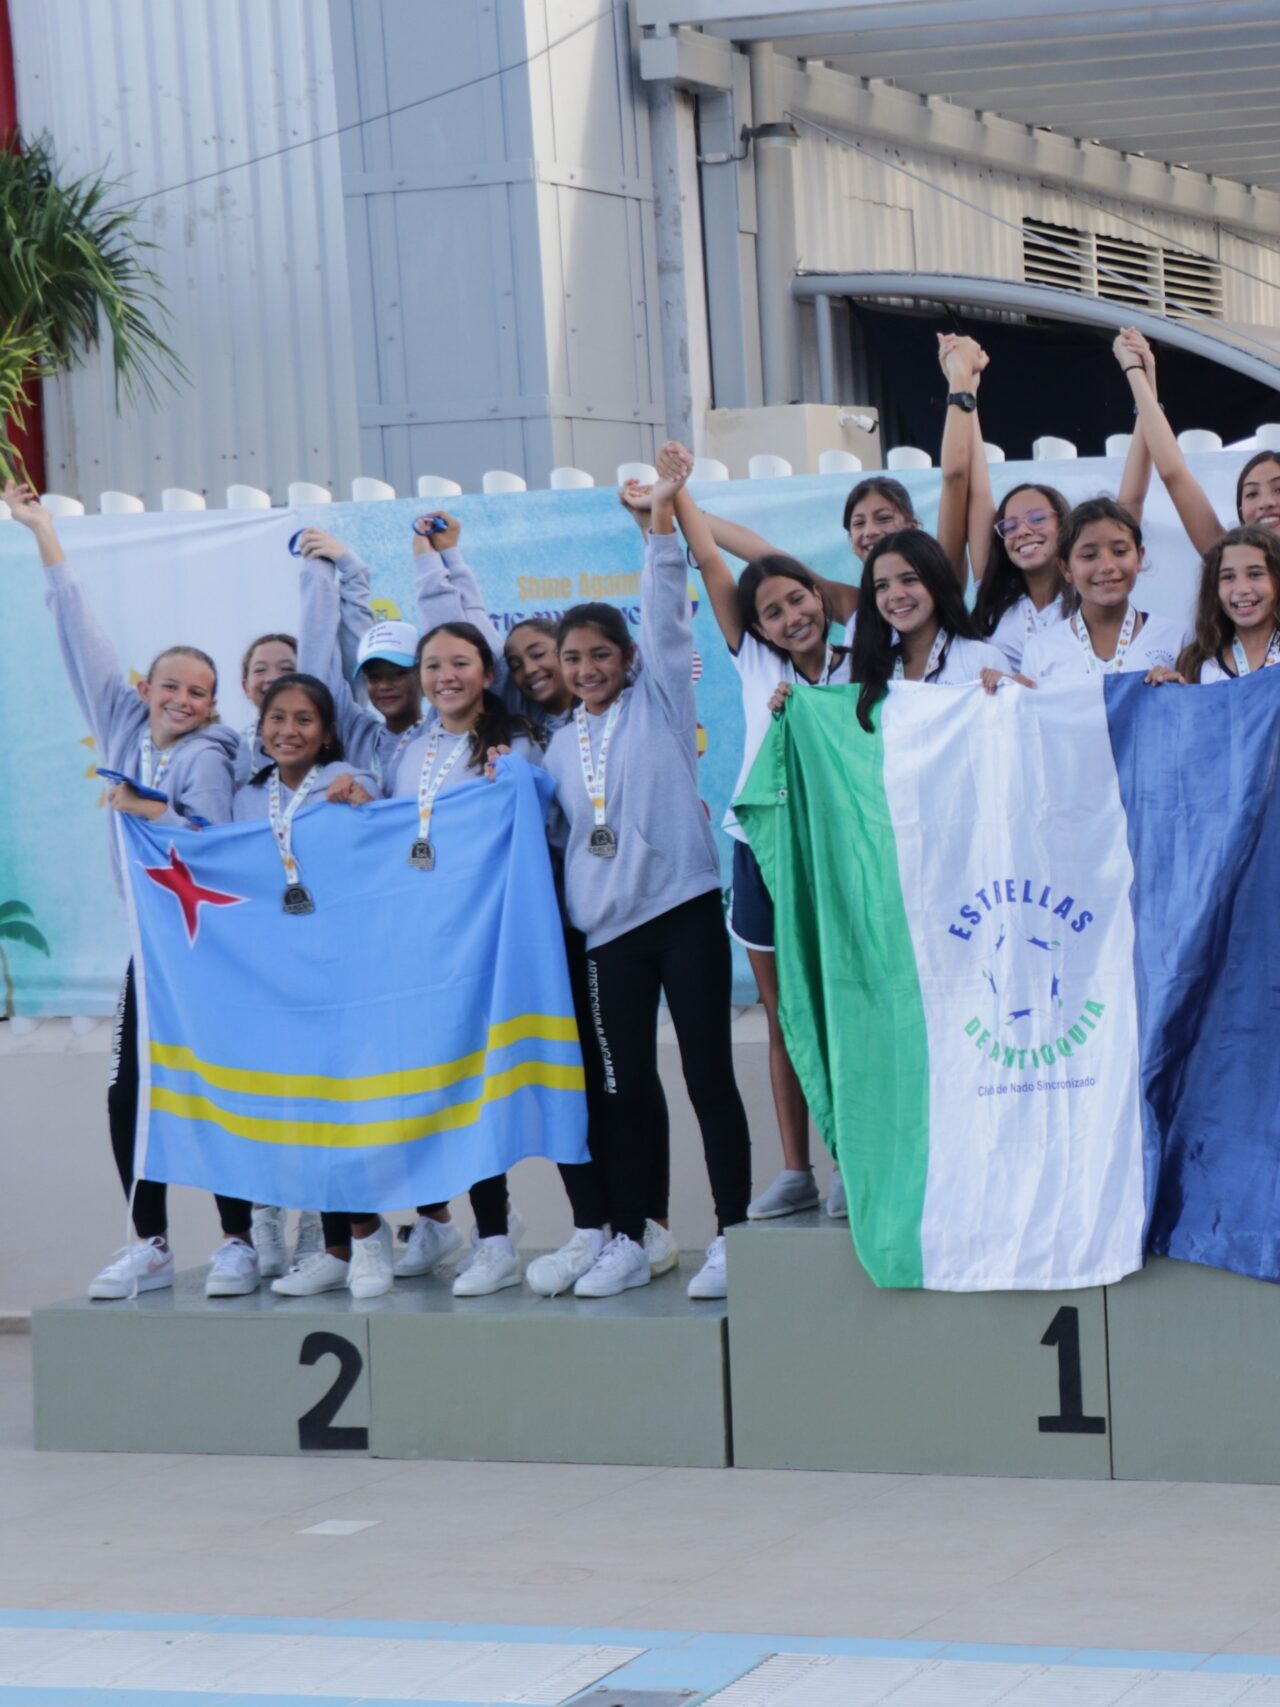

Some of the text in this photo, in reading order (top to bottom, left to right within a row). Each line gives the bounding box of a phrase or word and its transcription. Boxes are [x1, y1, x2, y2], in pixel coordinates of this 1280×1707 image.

[517, 575, 571, 600] Shine
[948, 879, 1094, 942] ESTRELLAS
[996, 1083, 1008, 1095] de
[1010, 1081, 1035, 1093] Nado
[1036, 1076, 1096, 1091] Sincronizado
[298, 1331, 369, 1450] 2
[1038, 1305, 1106, 1434] 1
